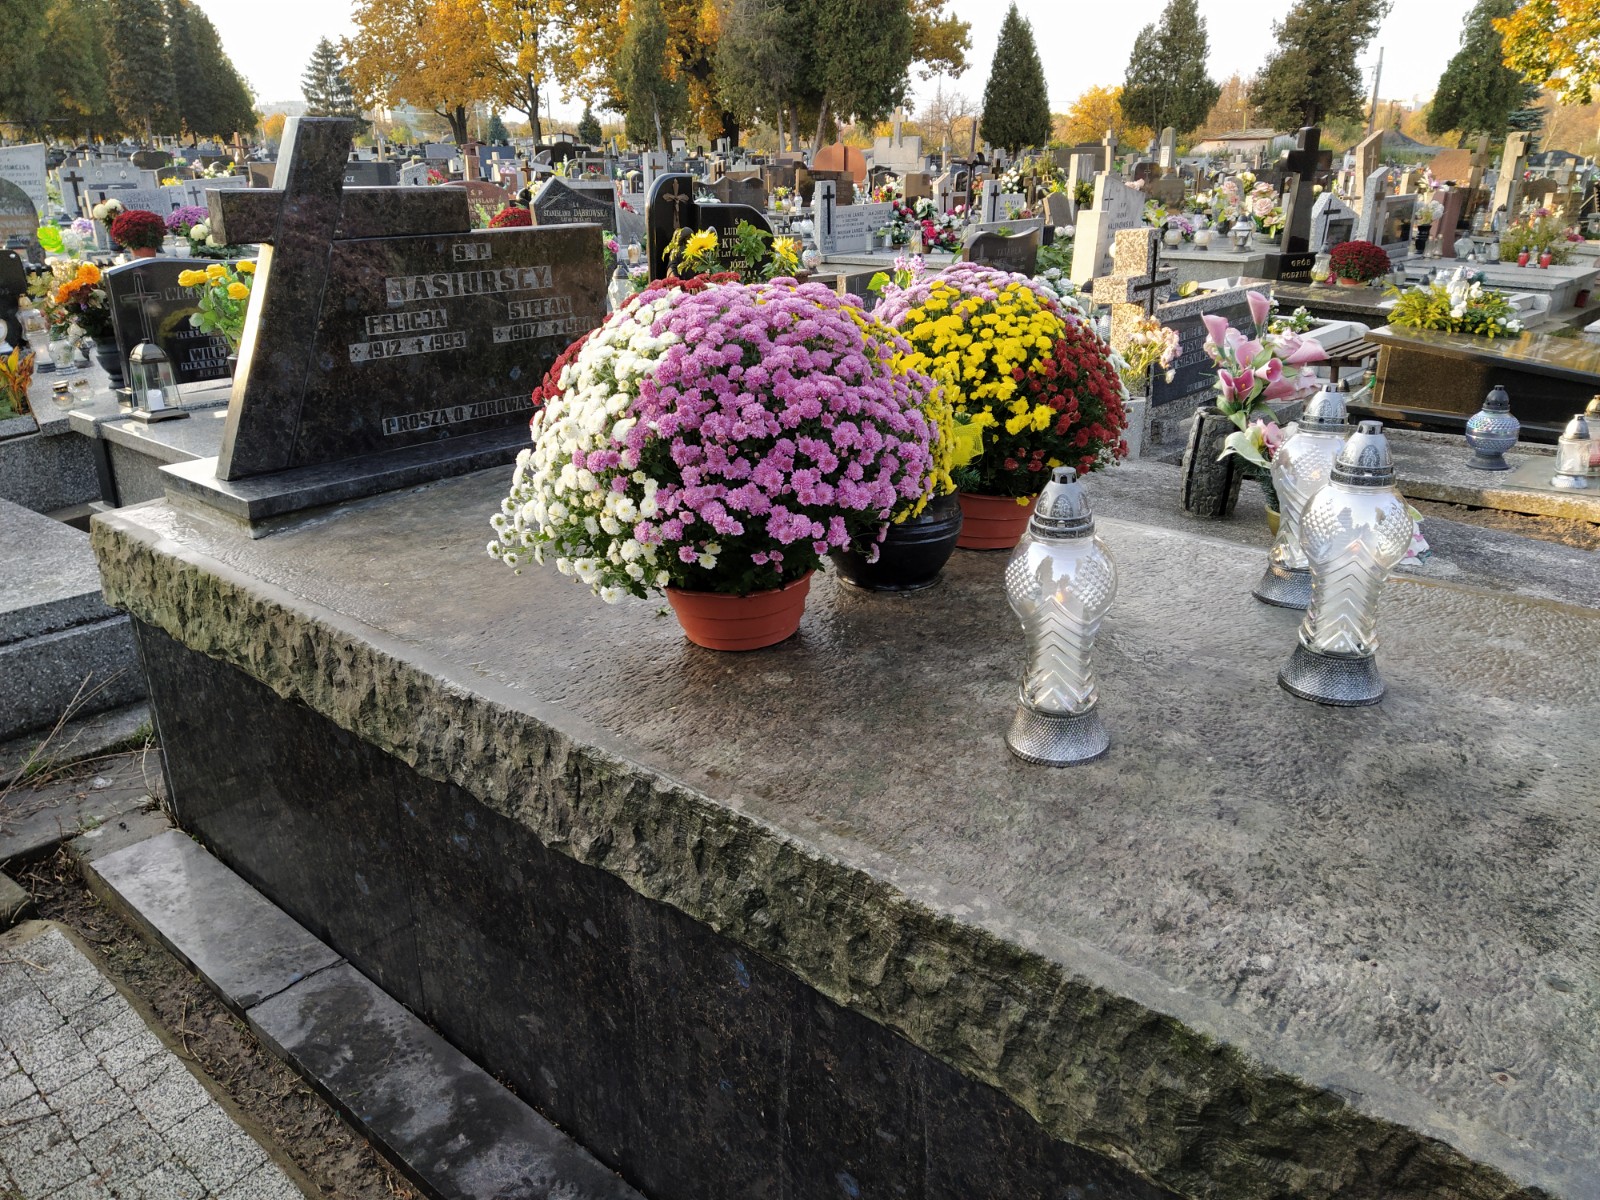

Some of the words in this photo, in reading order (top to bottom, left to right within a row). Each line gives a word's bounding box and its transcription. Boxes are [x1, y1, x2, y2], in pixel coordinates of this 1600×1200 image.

[509, 297, 571, 320] STEFAN
[366, 310, 446, 335] FELICJA
[508, 322, 541, 341] 1907
[367, 339, 402, 359] 1912
[429, 332, 465, 352] 1993
[453, 407, 465, 422] O
